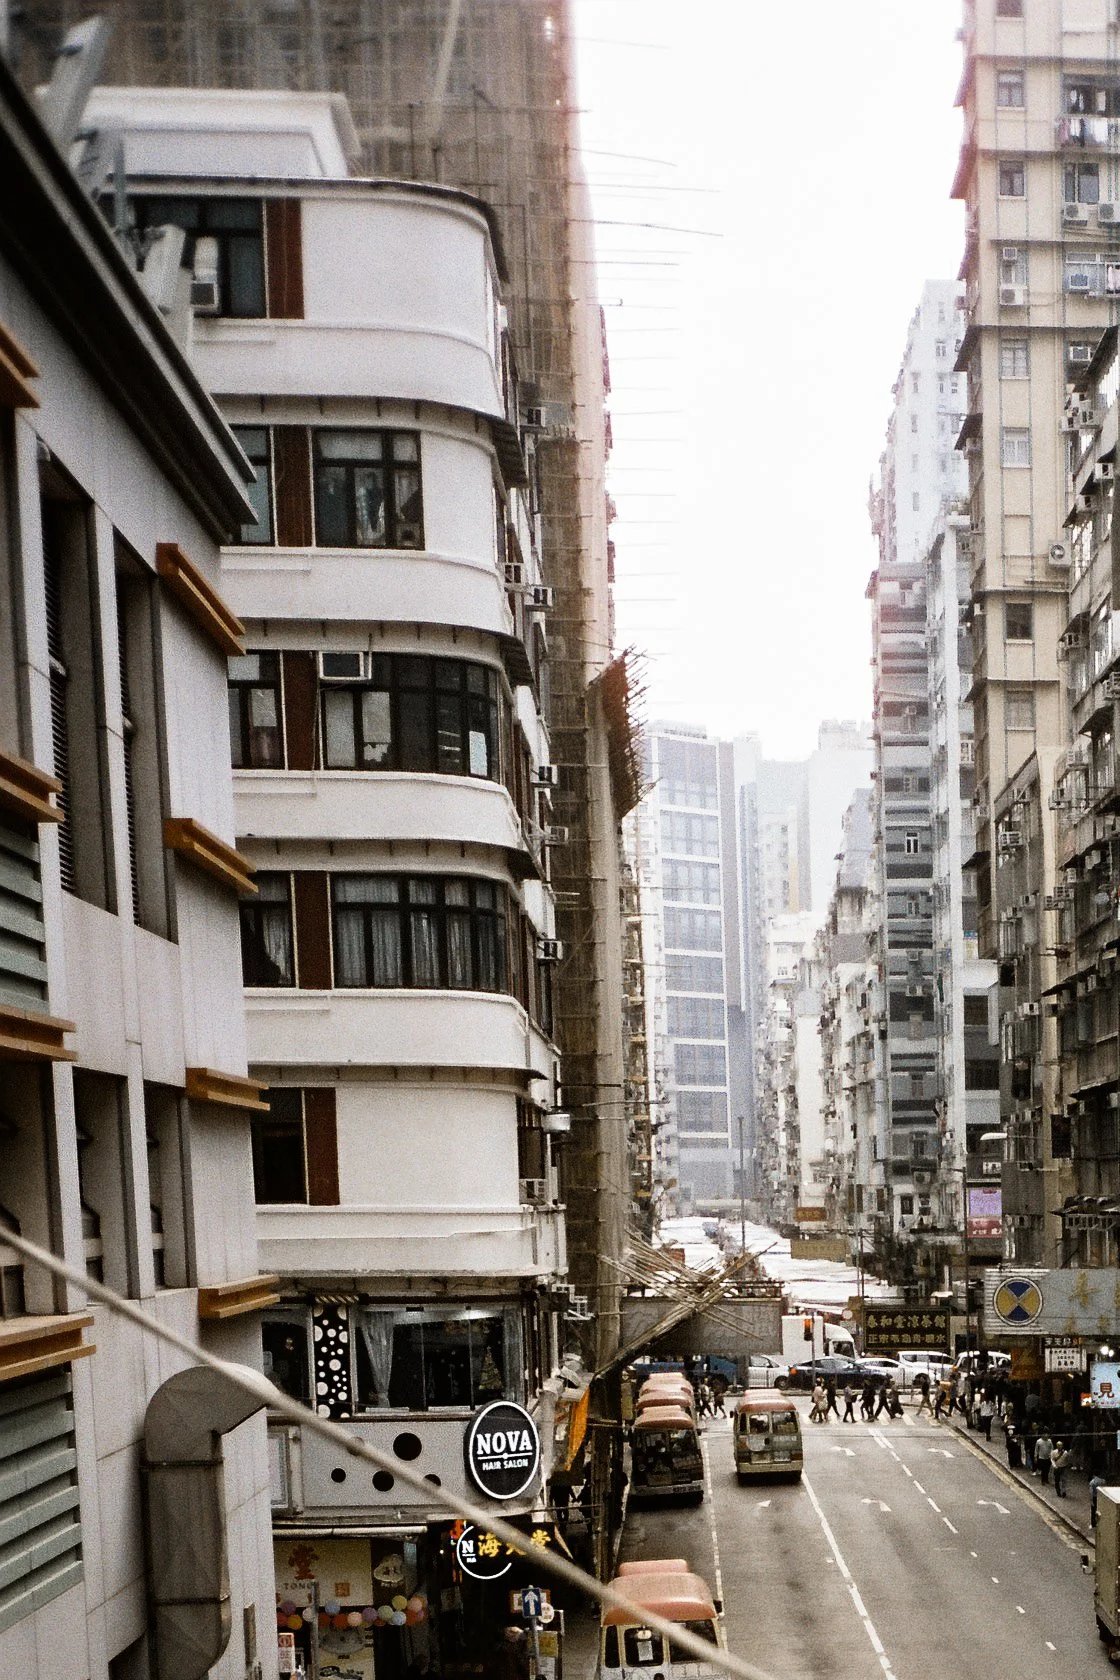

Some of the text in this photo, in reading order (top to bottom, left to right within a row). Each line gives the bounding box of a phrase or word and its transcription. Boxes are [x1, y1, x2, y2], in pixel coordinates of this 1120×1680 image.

[476, 1430, 533, 1455] NOVA
[482, 1458, 529, 1471] HAIR SALON
